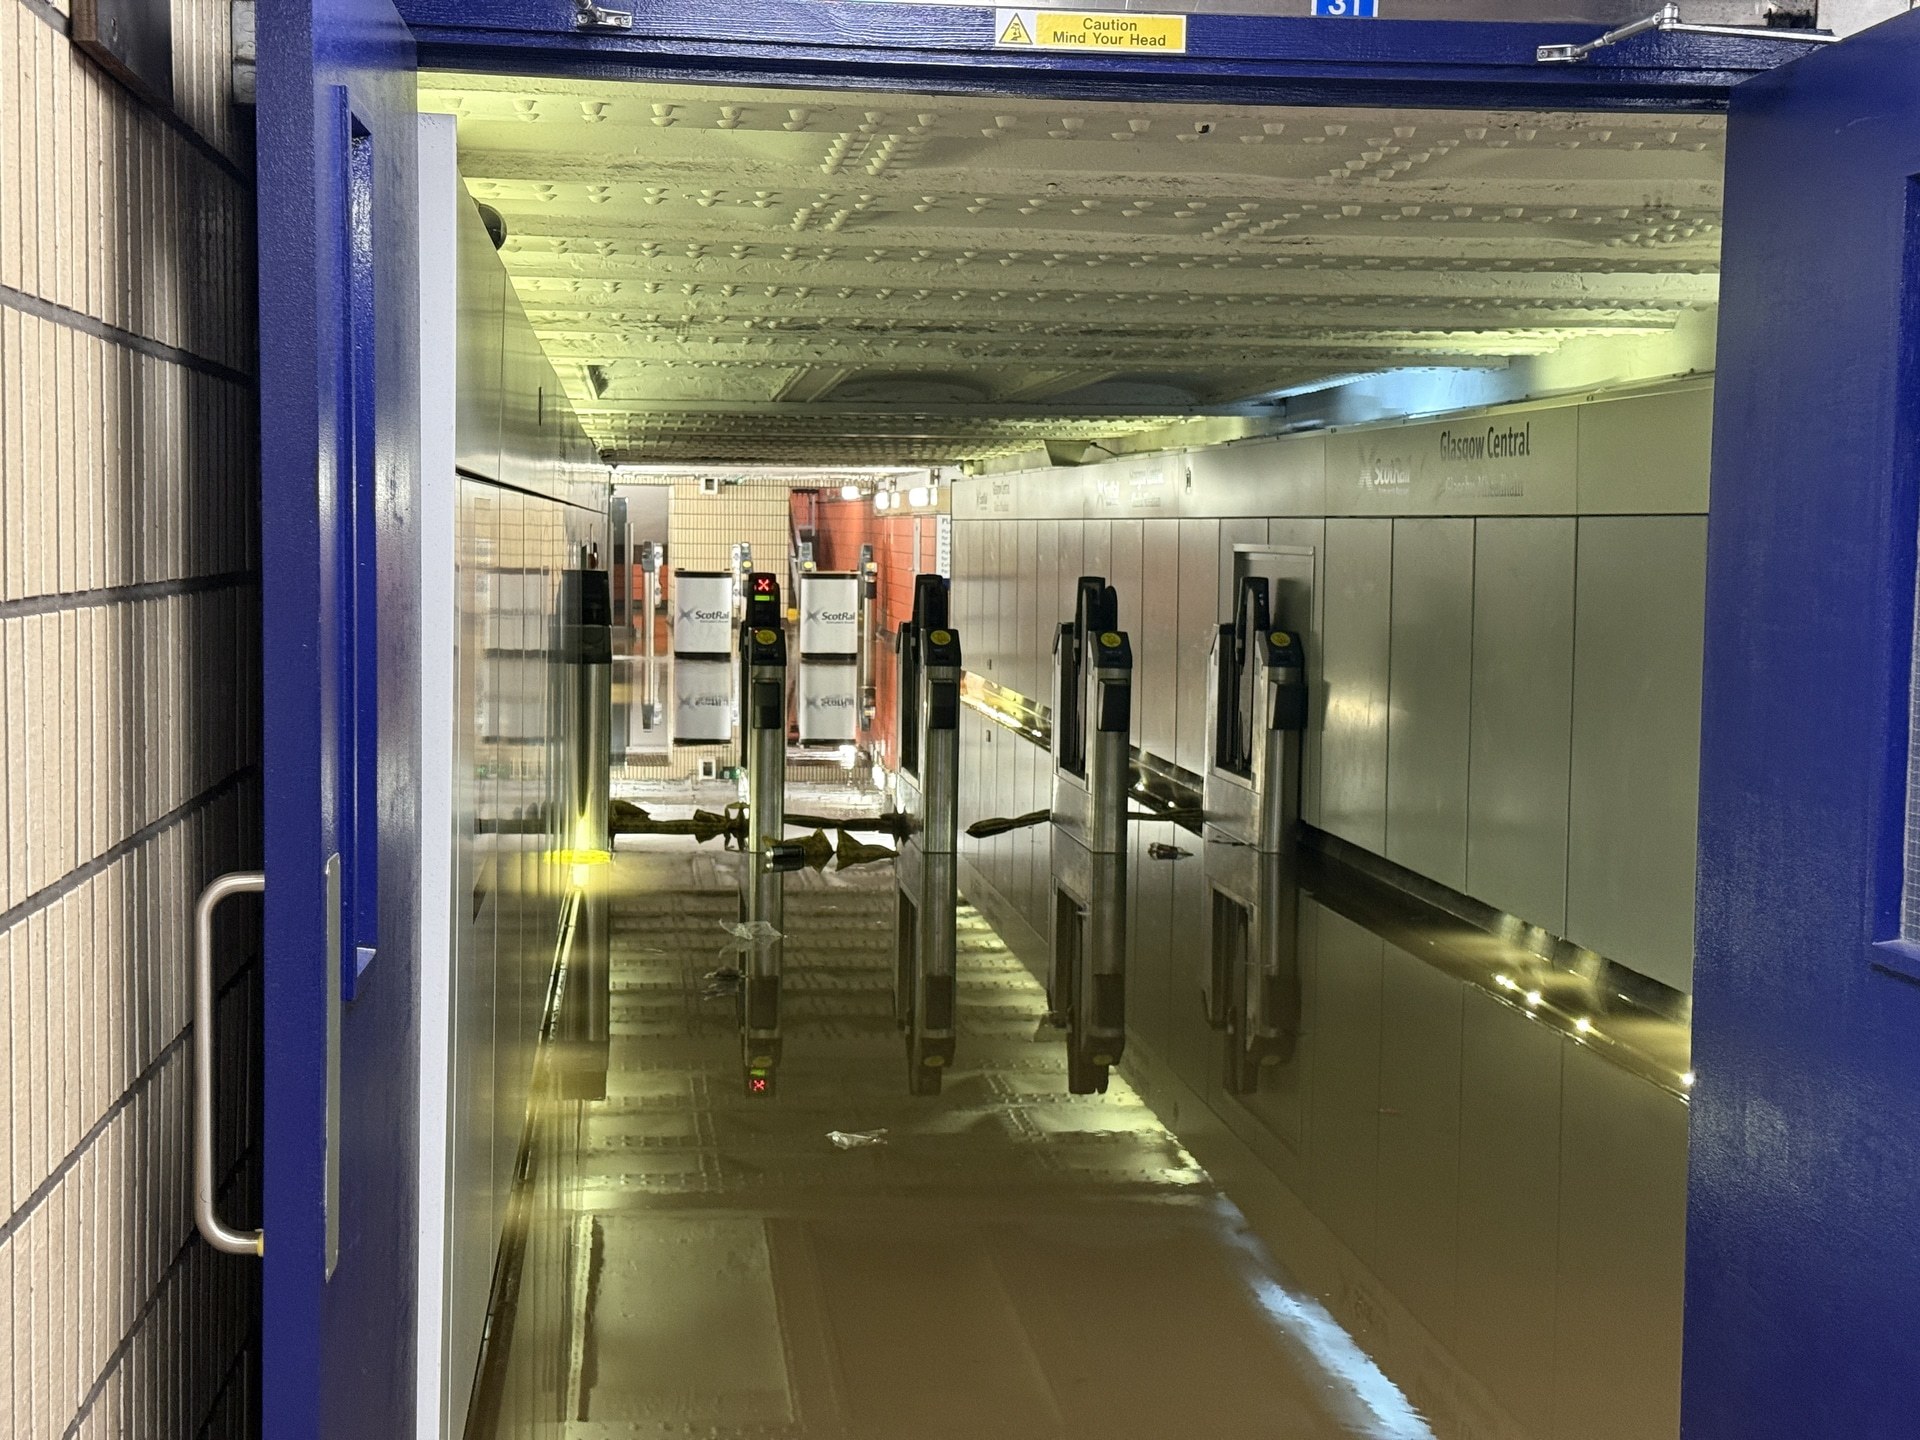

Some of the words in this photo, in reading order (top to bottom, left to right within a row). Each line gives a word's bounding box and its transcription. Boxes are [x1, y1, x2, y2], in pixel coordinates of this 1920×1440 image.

[1083, 18, 1137, 32] Caution
[1053, 32, 1089, 45] Mind
[1093, 33, 1123, 46] Your
[1130, 34, 1166, 47] Head
[1440, 430, 1484, 461] Glasgow
[1487, 421, 1530, 459] Central
